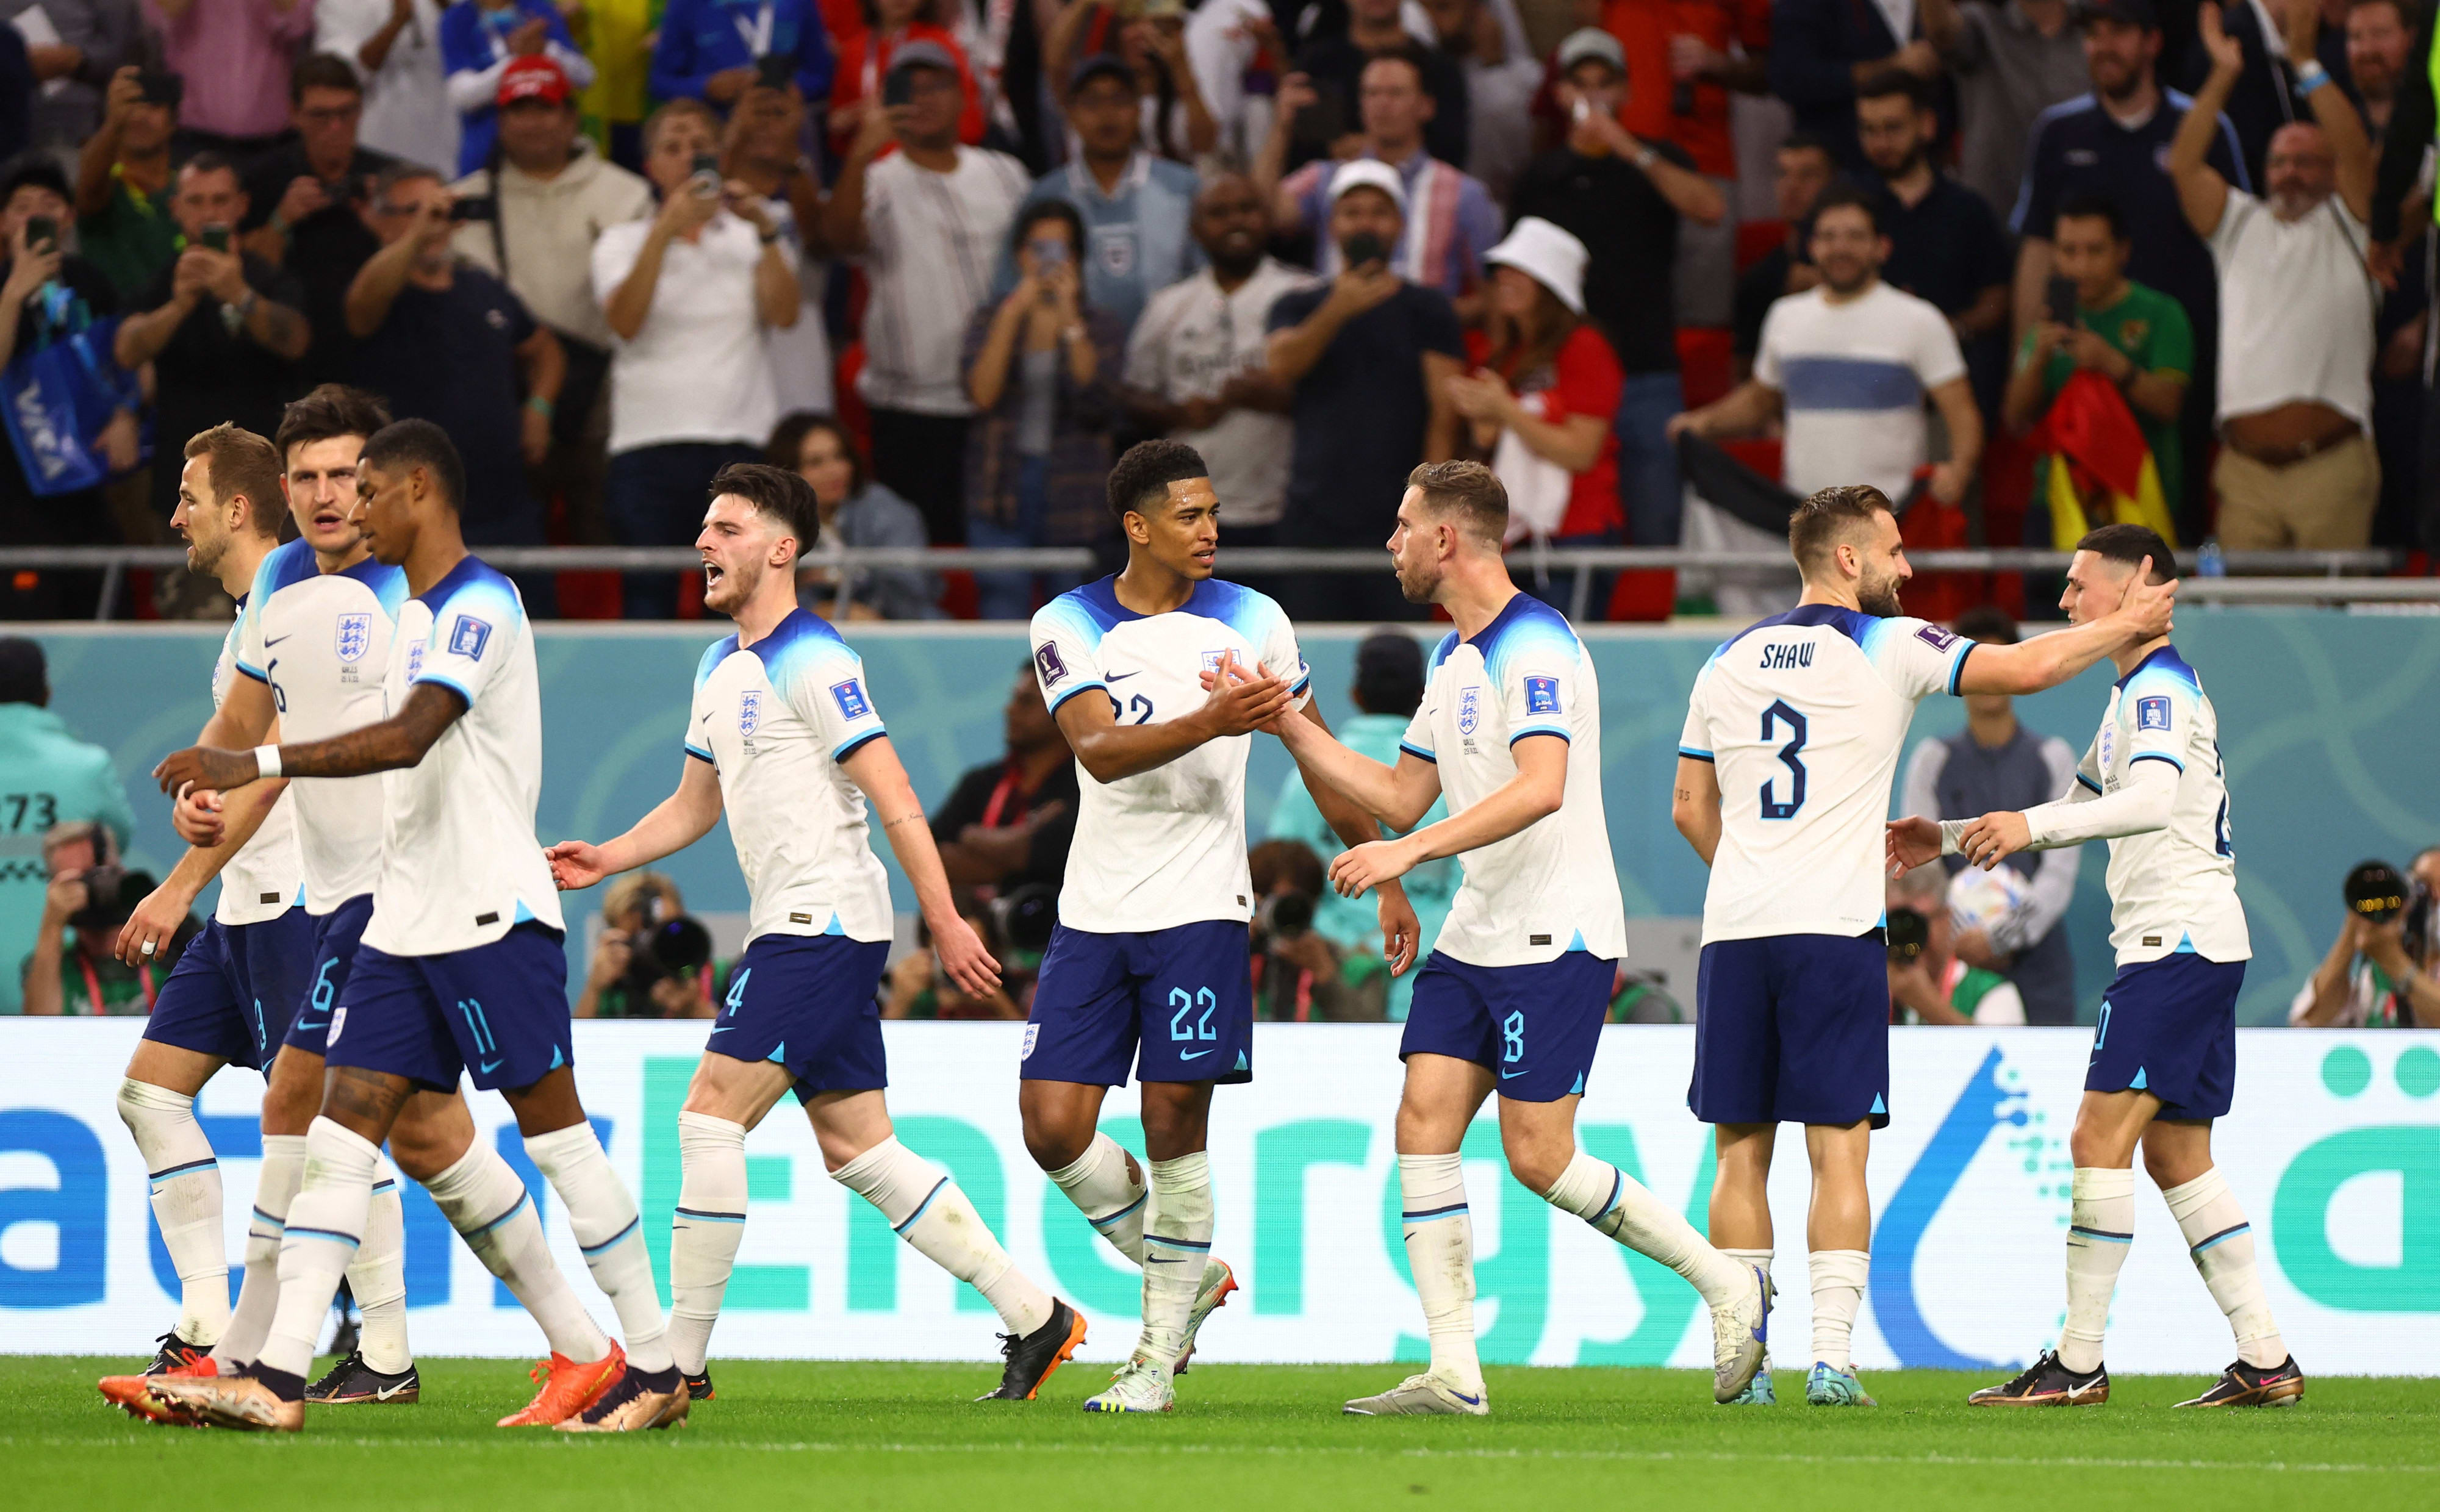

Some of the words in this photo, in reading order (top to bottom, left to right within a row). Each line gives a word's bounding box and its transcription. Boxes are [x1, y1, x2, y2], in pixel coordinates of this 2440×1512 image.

[1760, 642, 1815, 669] SHAW
[1759, 697, 1809, 820] 3
[0, 793, 58, 833] 73
[312, 956, 339, 1012] 6
[726, 967, 752, 1017] 4
[457, 998, 497, 1054] 11
[1169, 986, 1217, 1041] 22
[1503, 1009, 1524, 1062] 8
